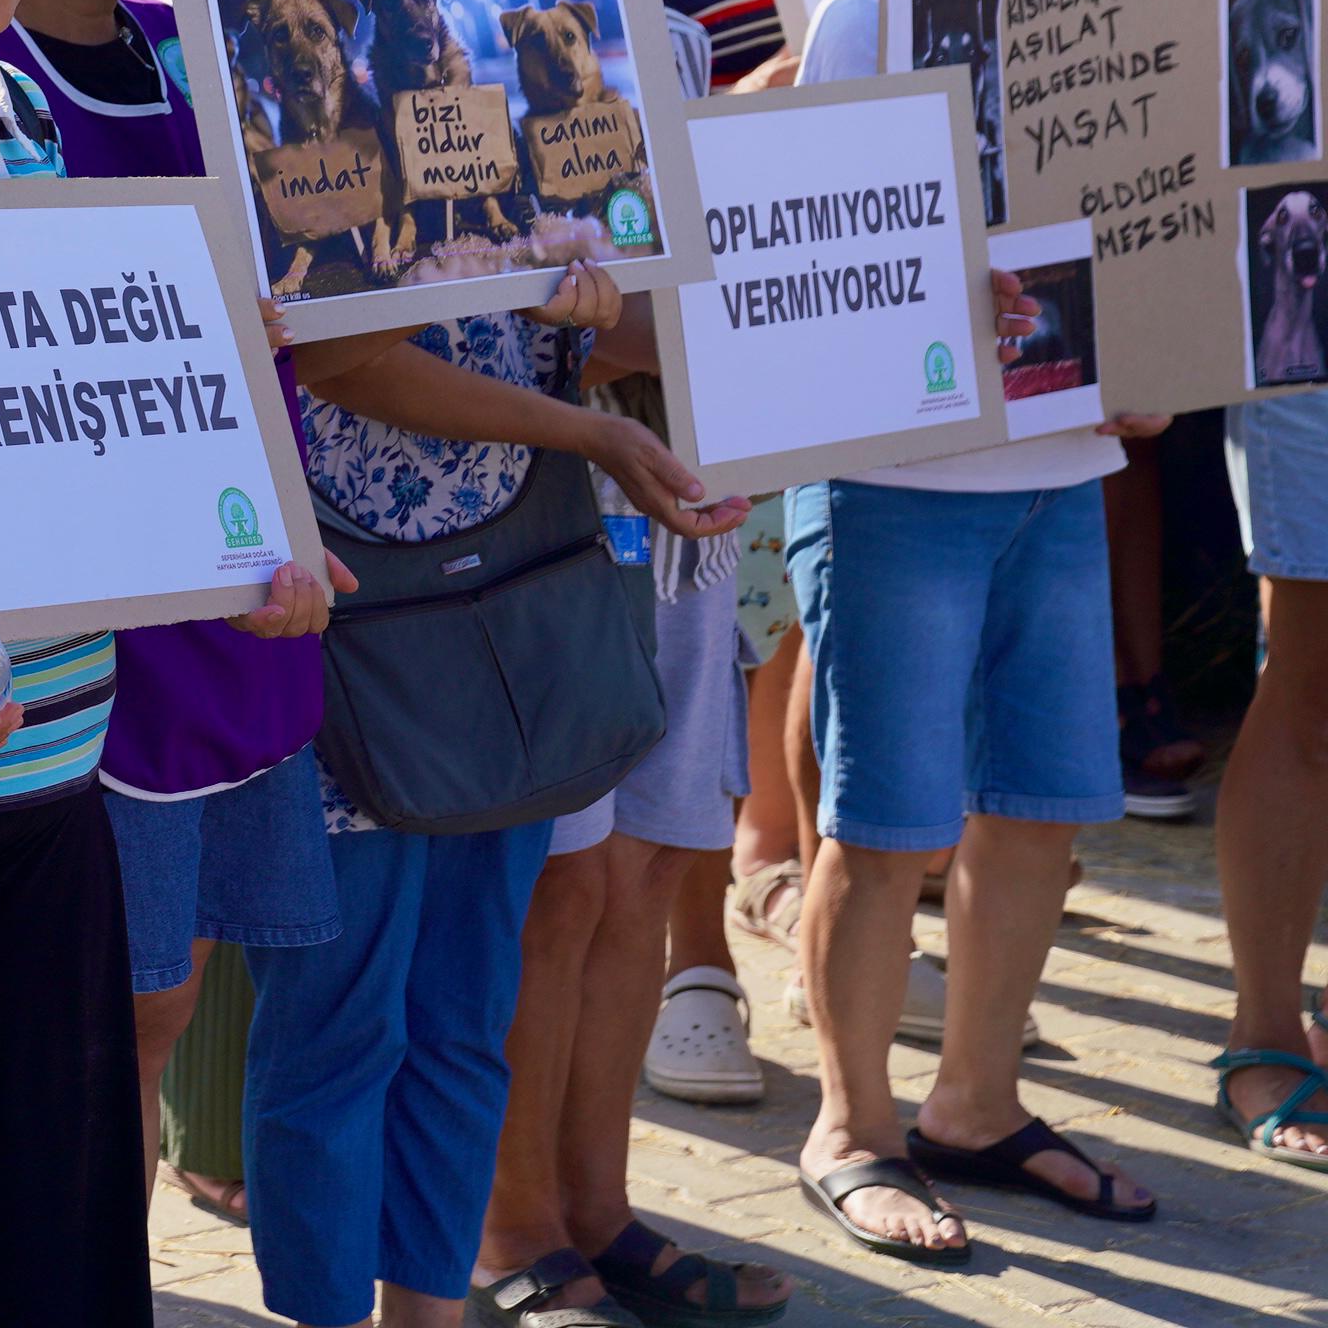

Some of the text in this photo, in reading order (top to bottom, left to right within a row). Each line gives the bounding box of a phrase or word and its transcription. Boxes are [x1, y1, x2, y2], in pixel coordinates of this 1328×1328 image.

[1005, 5, 1123, 68] AŞILAT
[412, 94, 464, 125] bizi
[540, 112, 620, 146] canımı
[1024, 91, 1159, 175] YAŞAT
[416, 123, 485, 156] öldür
[560, 145, 623, 181] alma
[277, 151, 372, 200] imdat
[423, 156, 501, 194] meyin
[1079, 153, 1197, 218] ÖLDÜRE
[705, 180, 945, 255] OPLATMIYORUZ
[59, 270, 202, 346] DEĞİL
[721, 259, 926, 330] VERMİYORUZ
